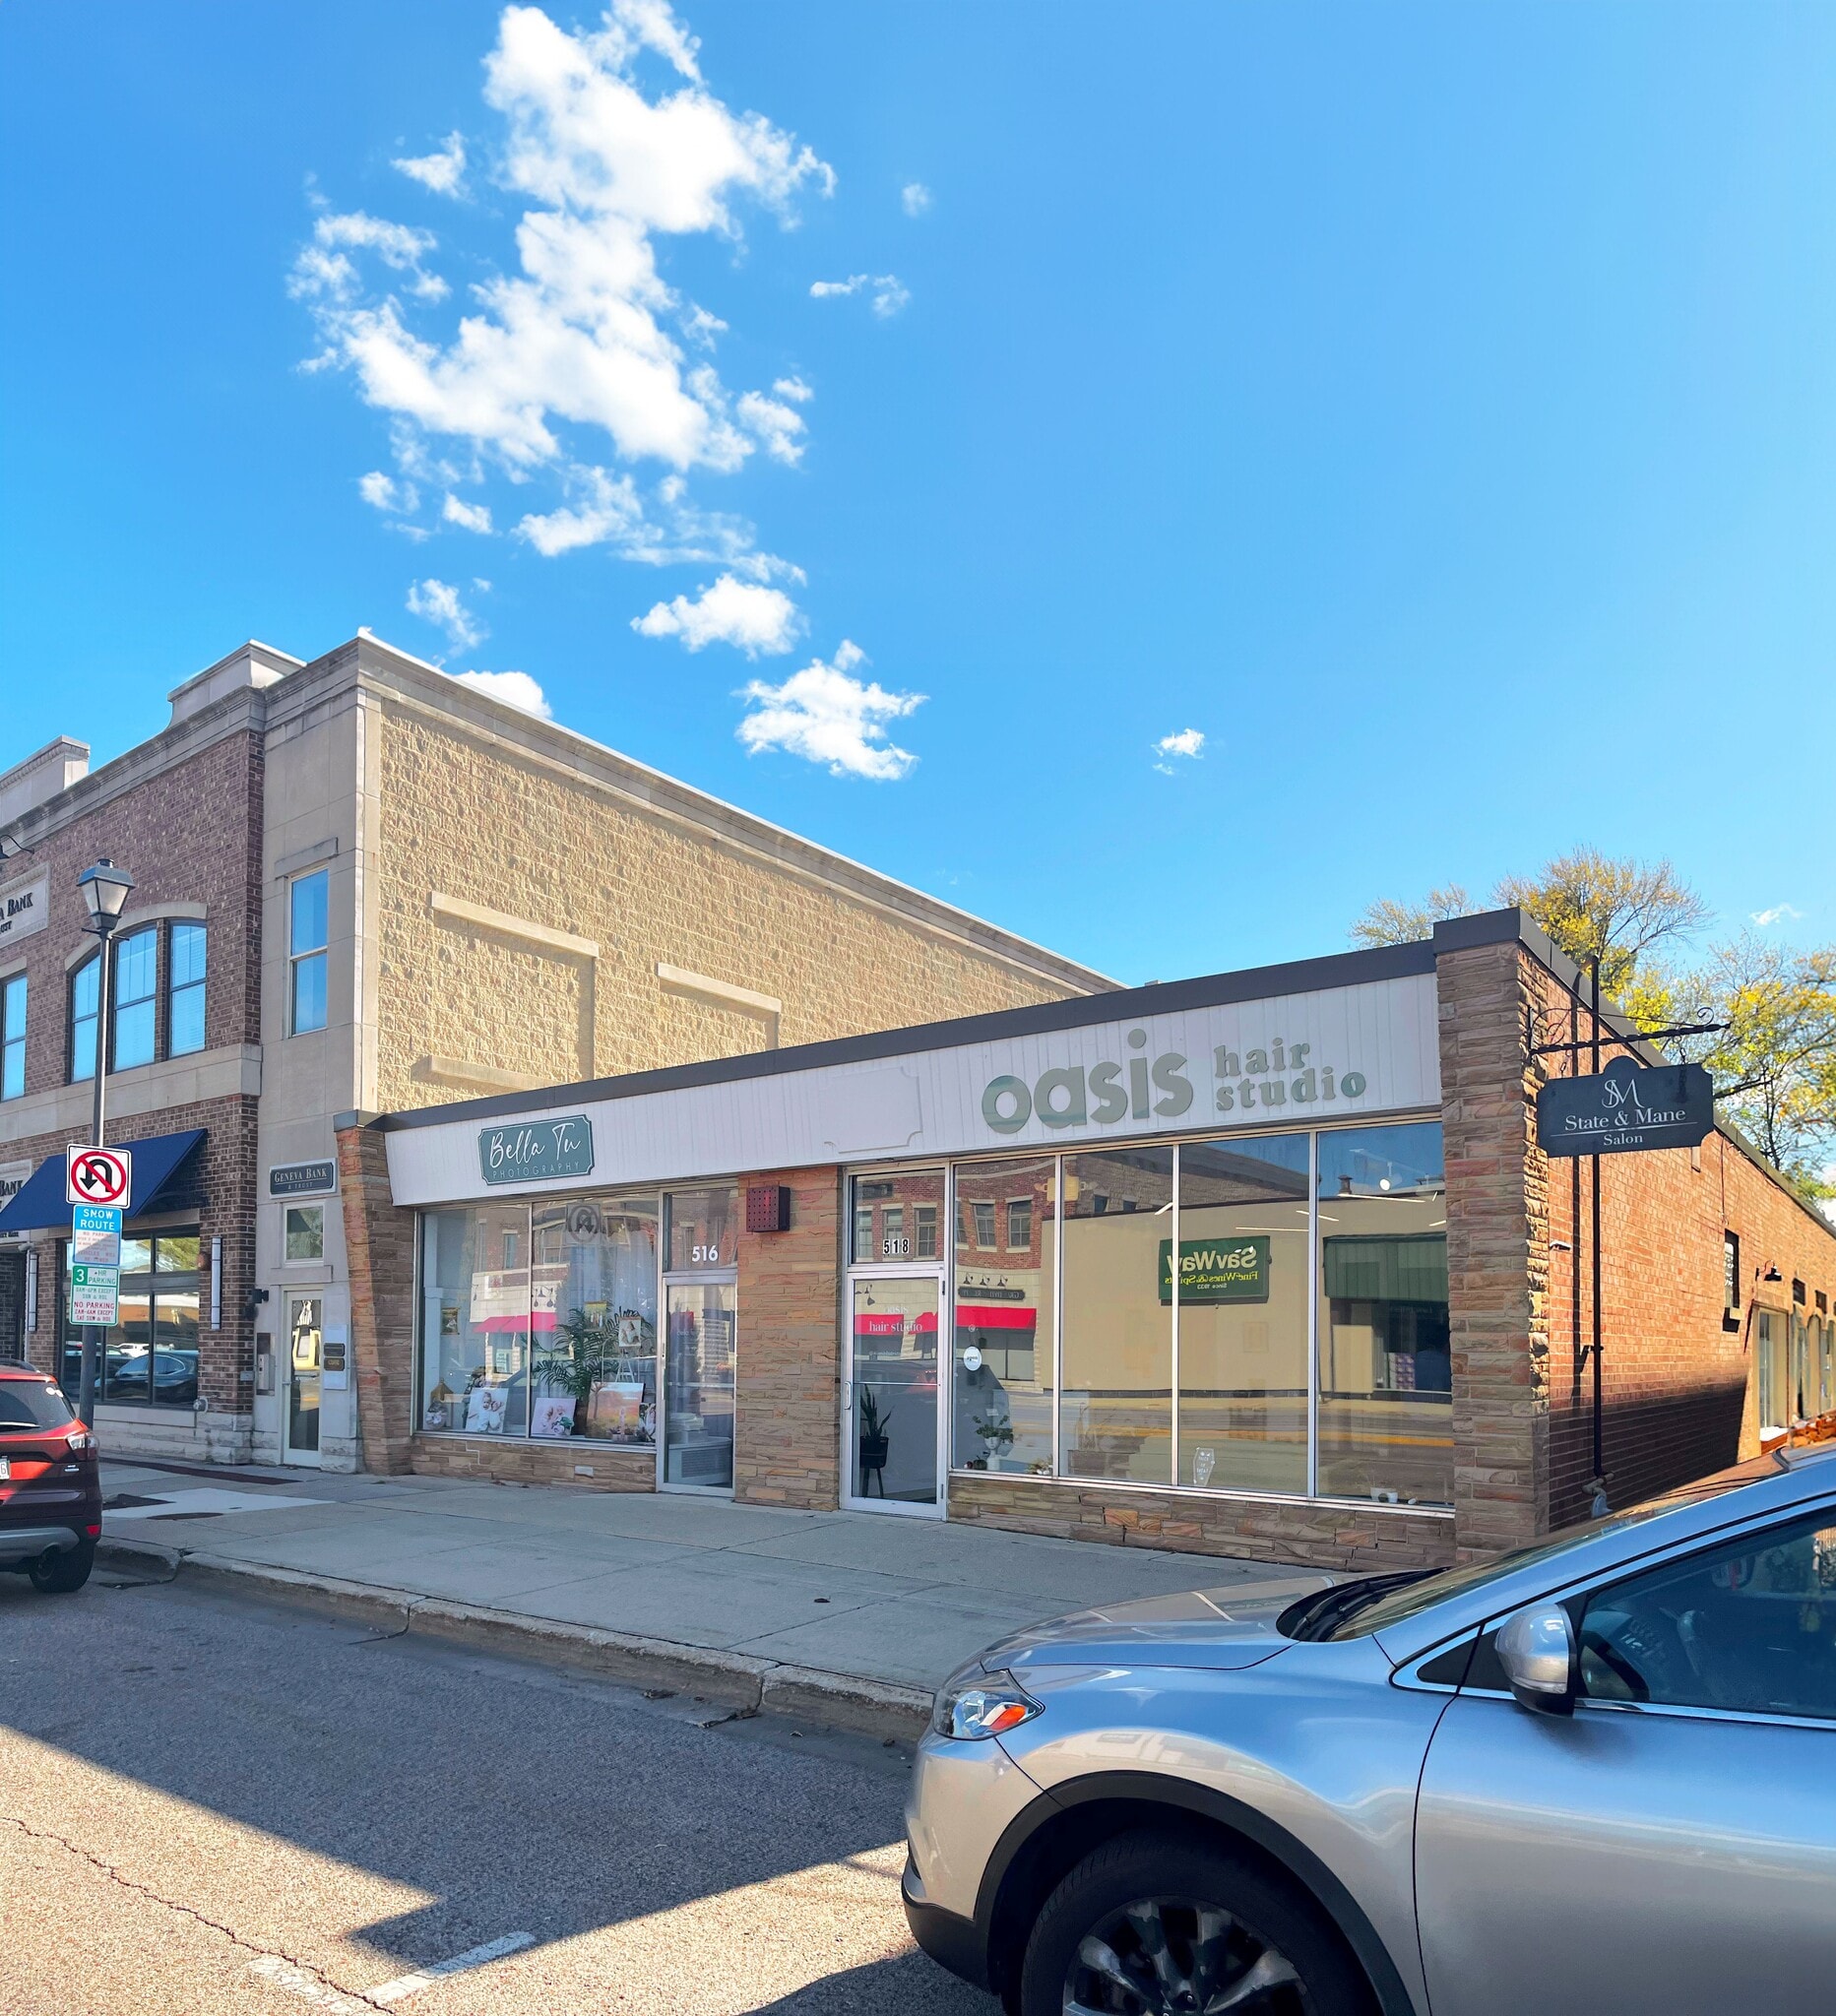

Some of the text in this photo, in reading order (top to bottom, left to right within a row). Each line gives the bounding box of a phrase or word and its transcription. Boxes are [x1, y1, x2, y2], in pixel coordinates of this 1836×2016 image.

[7, 892, 33, 916] BANK
[1214, 1038, 1311, 1079] hair
[981, 1028, 1194, 1135] oasis
[1215, 1066, 1367, 1111] studio
[1564, 1107, 1686, 1131] State & Mane
[1603, 1134, 1643, 1146] Salon
[489, 1130, 545, 1168] Bella
[275, 1167, 328, 1183] GENEVA BANK
[492, 1162, 580, 1179] PHOTOGRAPHY
[83, 1209, 114, 1220] SNOW
[80, 1220, 115, 1230] ROUTE
[691, 1245, 719, 1262] 516
[883, 1238, 909, 1254] 518
[76, 1269, 85, 1283] 3
[869, 1320, 922, 1332] hair studio
